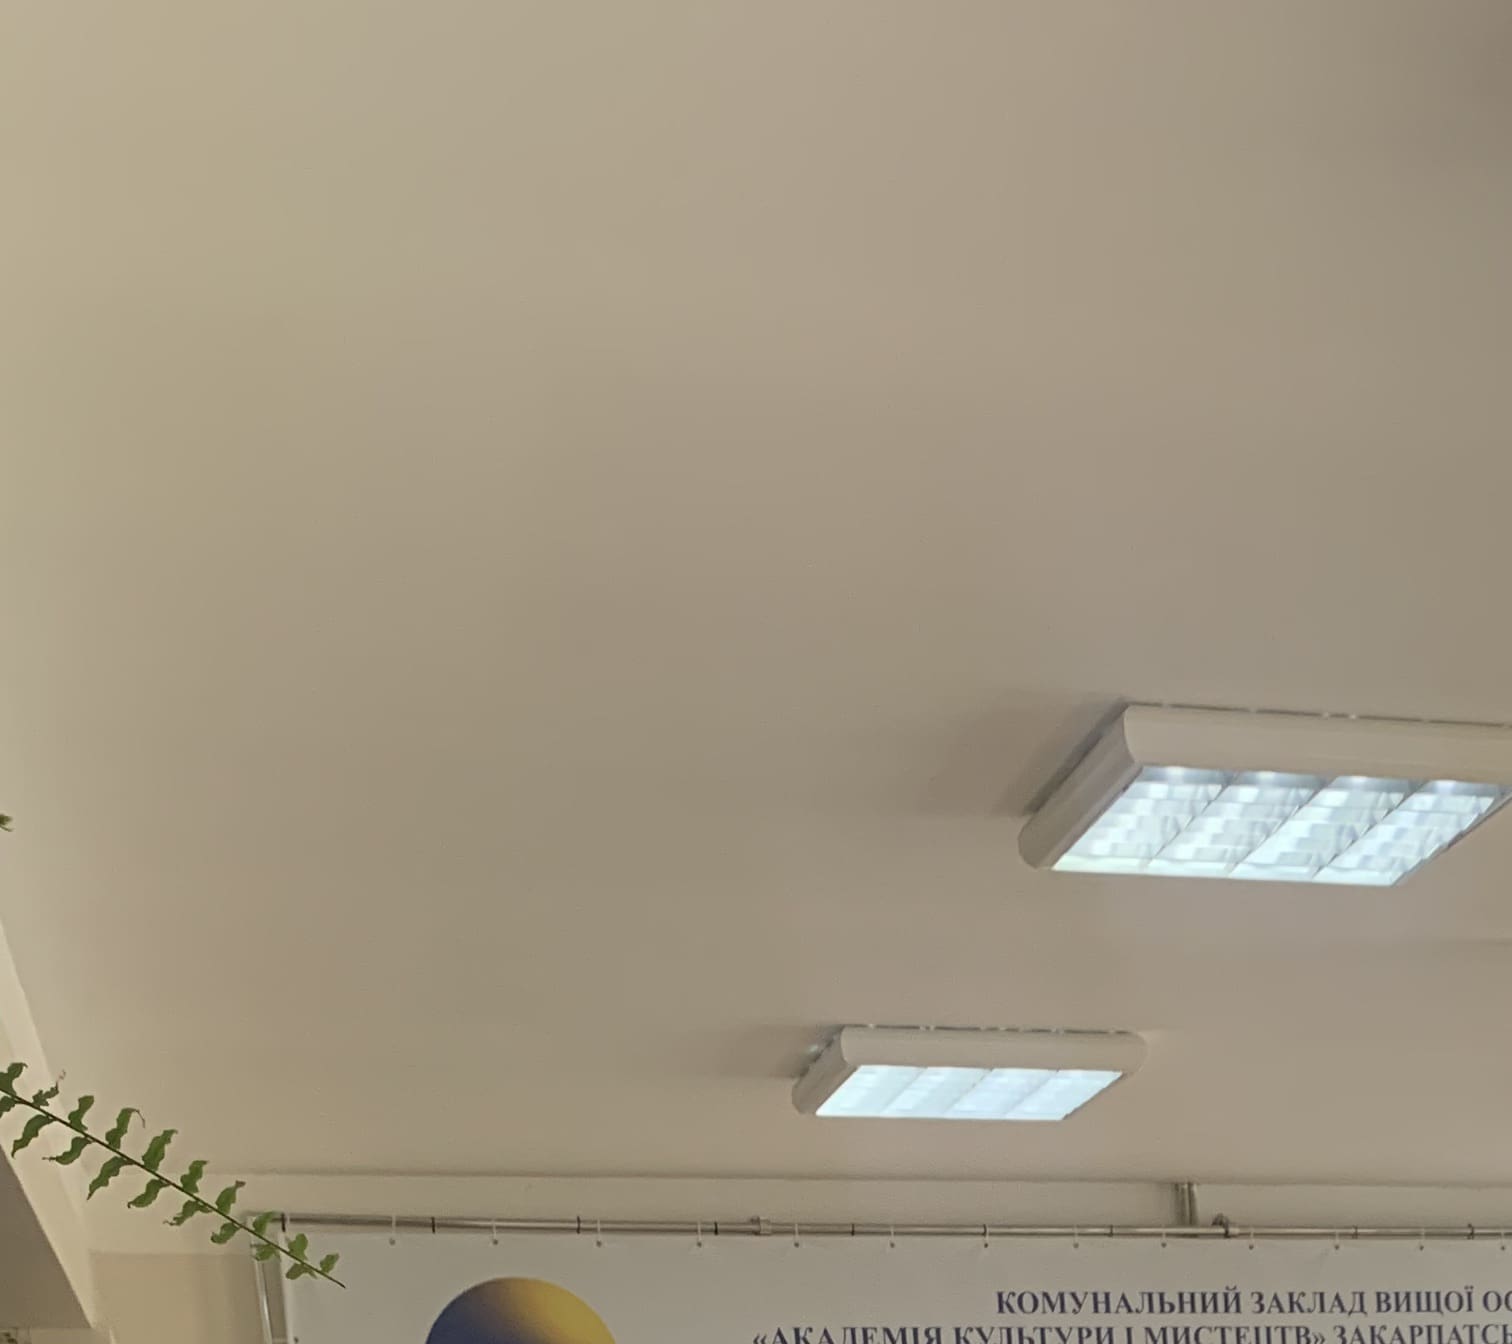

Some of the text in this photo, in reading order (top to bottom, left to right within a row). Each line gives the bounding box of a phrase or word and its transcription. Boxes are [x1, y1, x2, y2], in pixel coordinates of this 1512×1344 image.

[997, 1286, 1241, 1315] КОМУНАЛЬНИЙ
[1251, 1292, 1367, 1316] ЗАКЛАД
[1376, 1286, 1473, 1315] ВИЩОЇ
